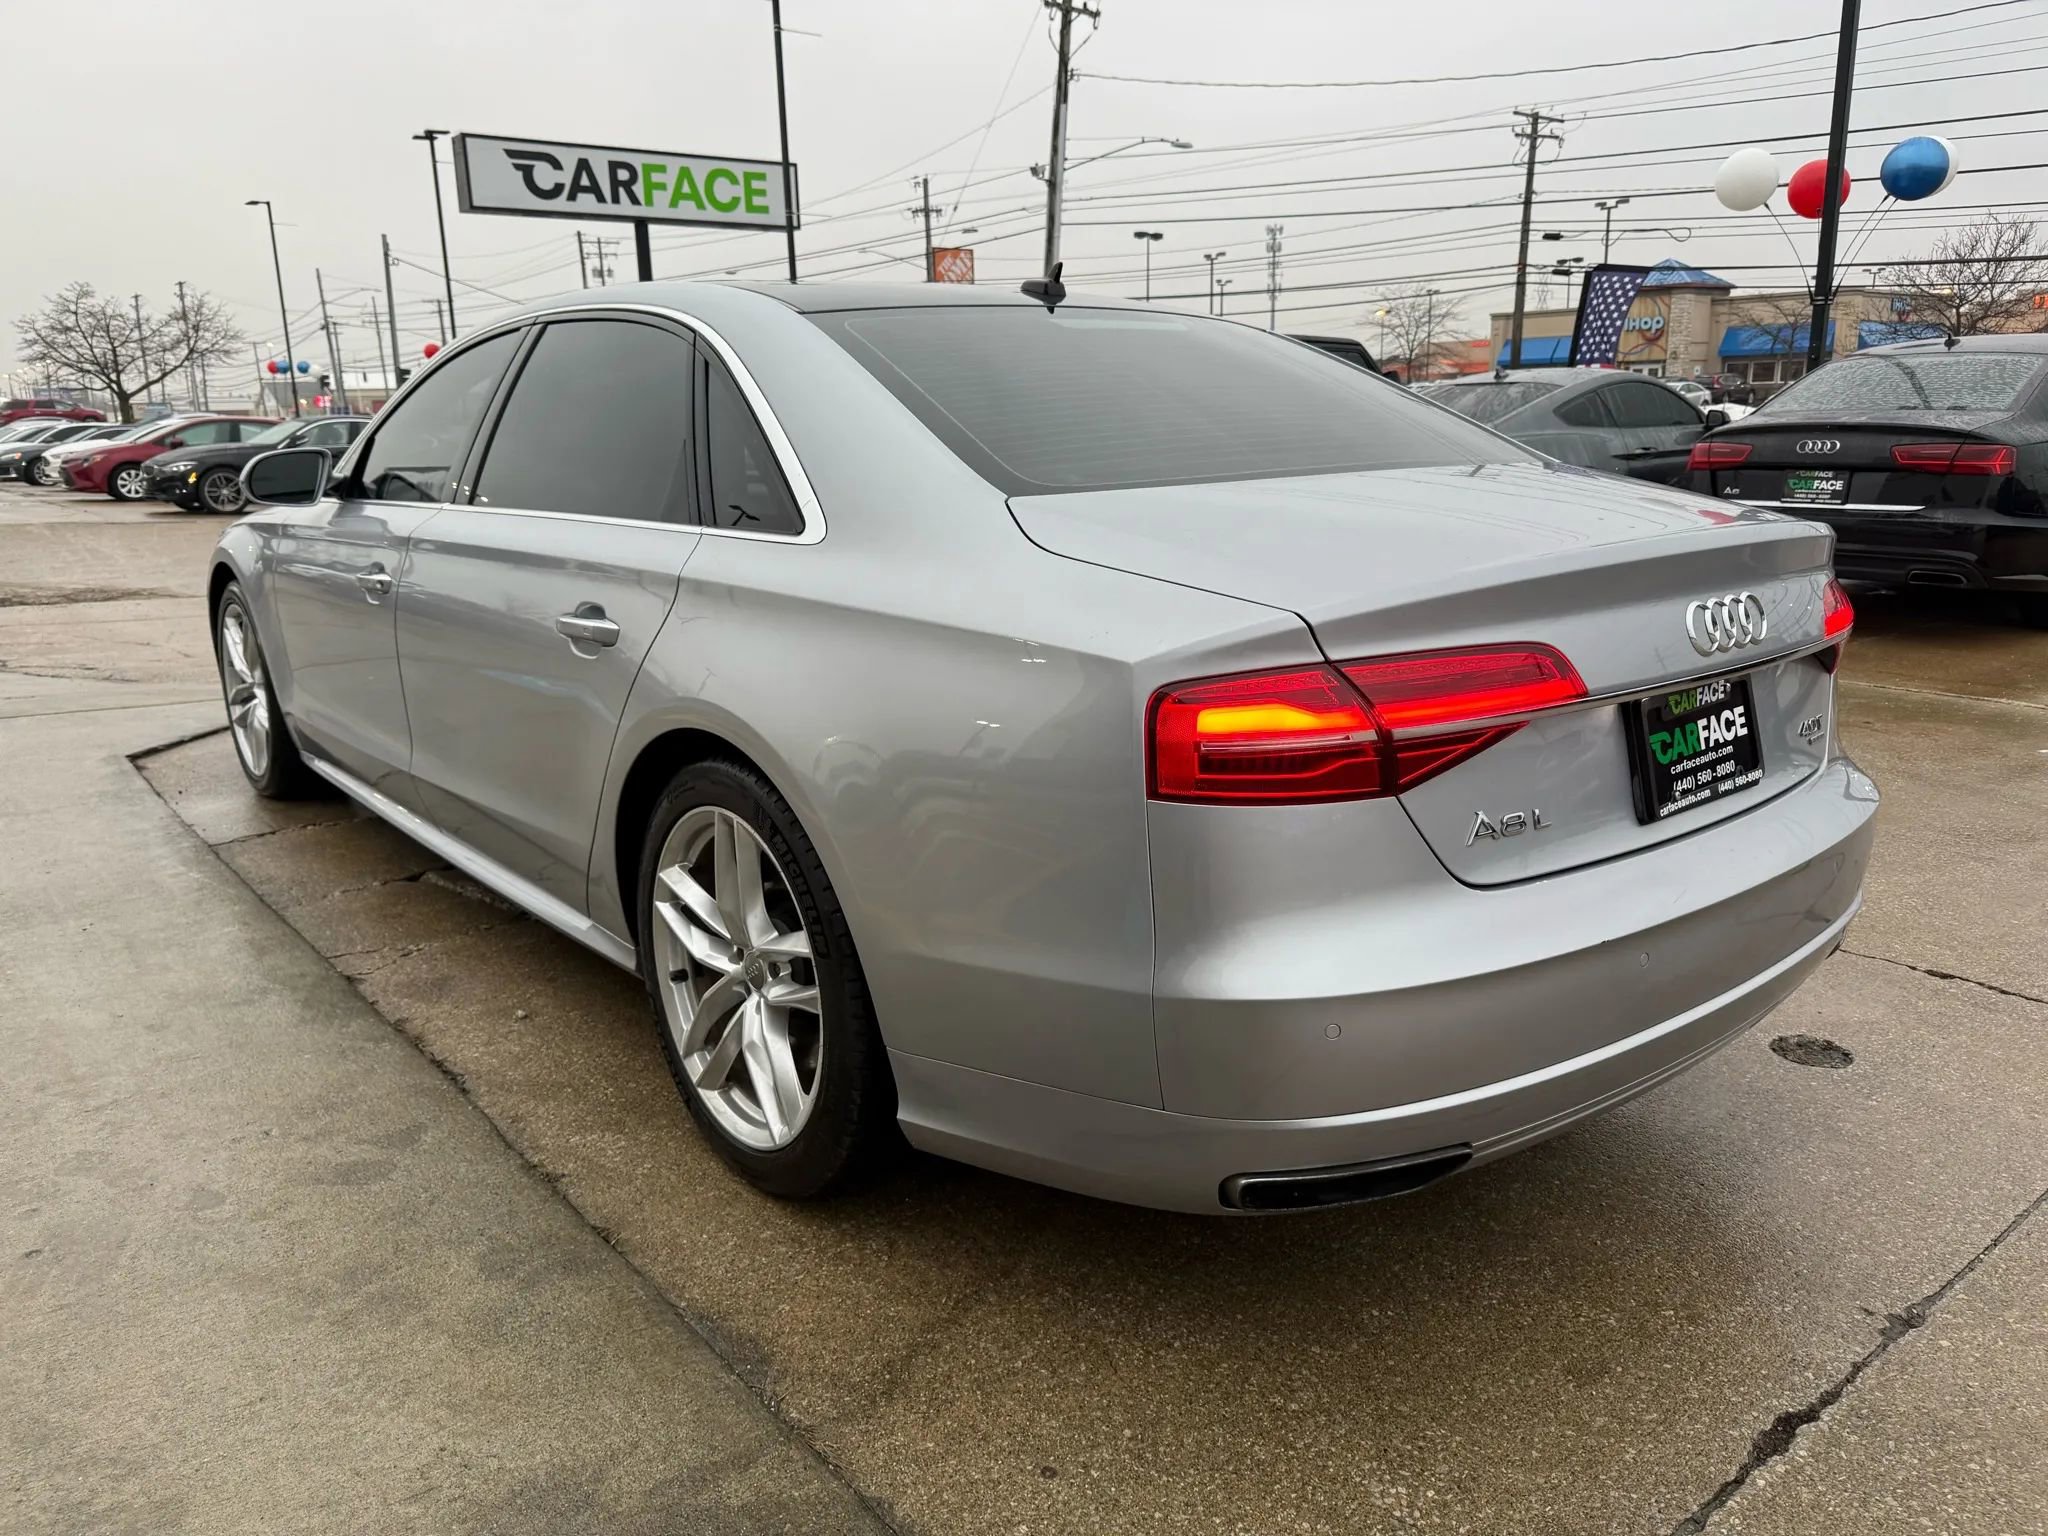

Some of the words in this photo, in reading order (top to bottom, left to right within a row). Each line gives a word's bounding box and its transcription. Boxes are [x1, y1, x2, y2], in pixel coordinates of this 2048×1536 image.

[502, 148, 770, 215] CARFACE
[1787, 479, 1844, 490] CARFACE
[1669, 680, 1725, 715] CARFACE
[1649, 705, 1748, 765] CARFACE
[1671, 745, 1734, 774] carfaceauto.com
[1660, 789, 1711, 816] carfaceauto.com
[1718, 779, 1735, 794] (440)
[1735, 769, 1763, 787] 560-8080
[1673, 775, 1696, 792] (440)
